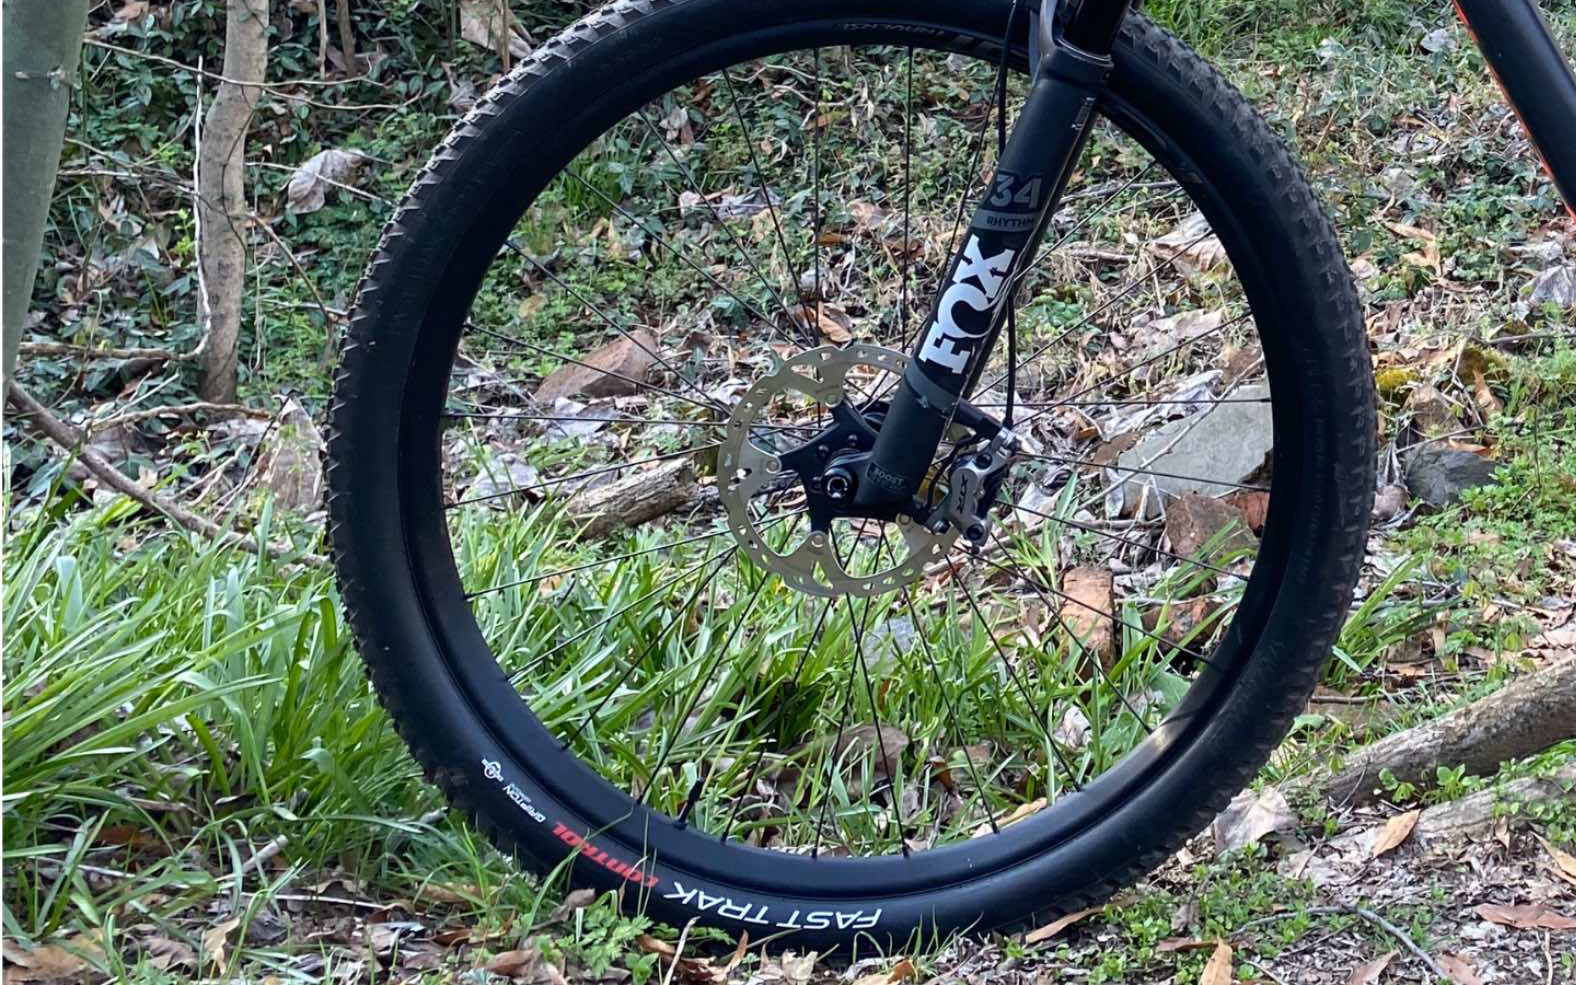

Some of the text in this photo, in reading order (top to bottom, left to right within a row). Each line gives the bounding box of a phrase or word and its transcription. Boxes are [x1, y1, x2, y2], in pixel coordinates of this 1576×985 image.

[990, 174, 1042, 209] 34
[986, 215, 1036, 228] RHYTHM
[918, 233, 1016, 375] FOX
[552, 821, 659, 888] CONTROL
[663, 881, 769, 925] TRAK
[775, 908, 883, 930] FAST
